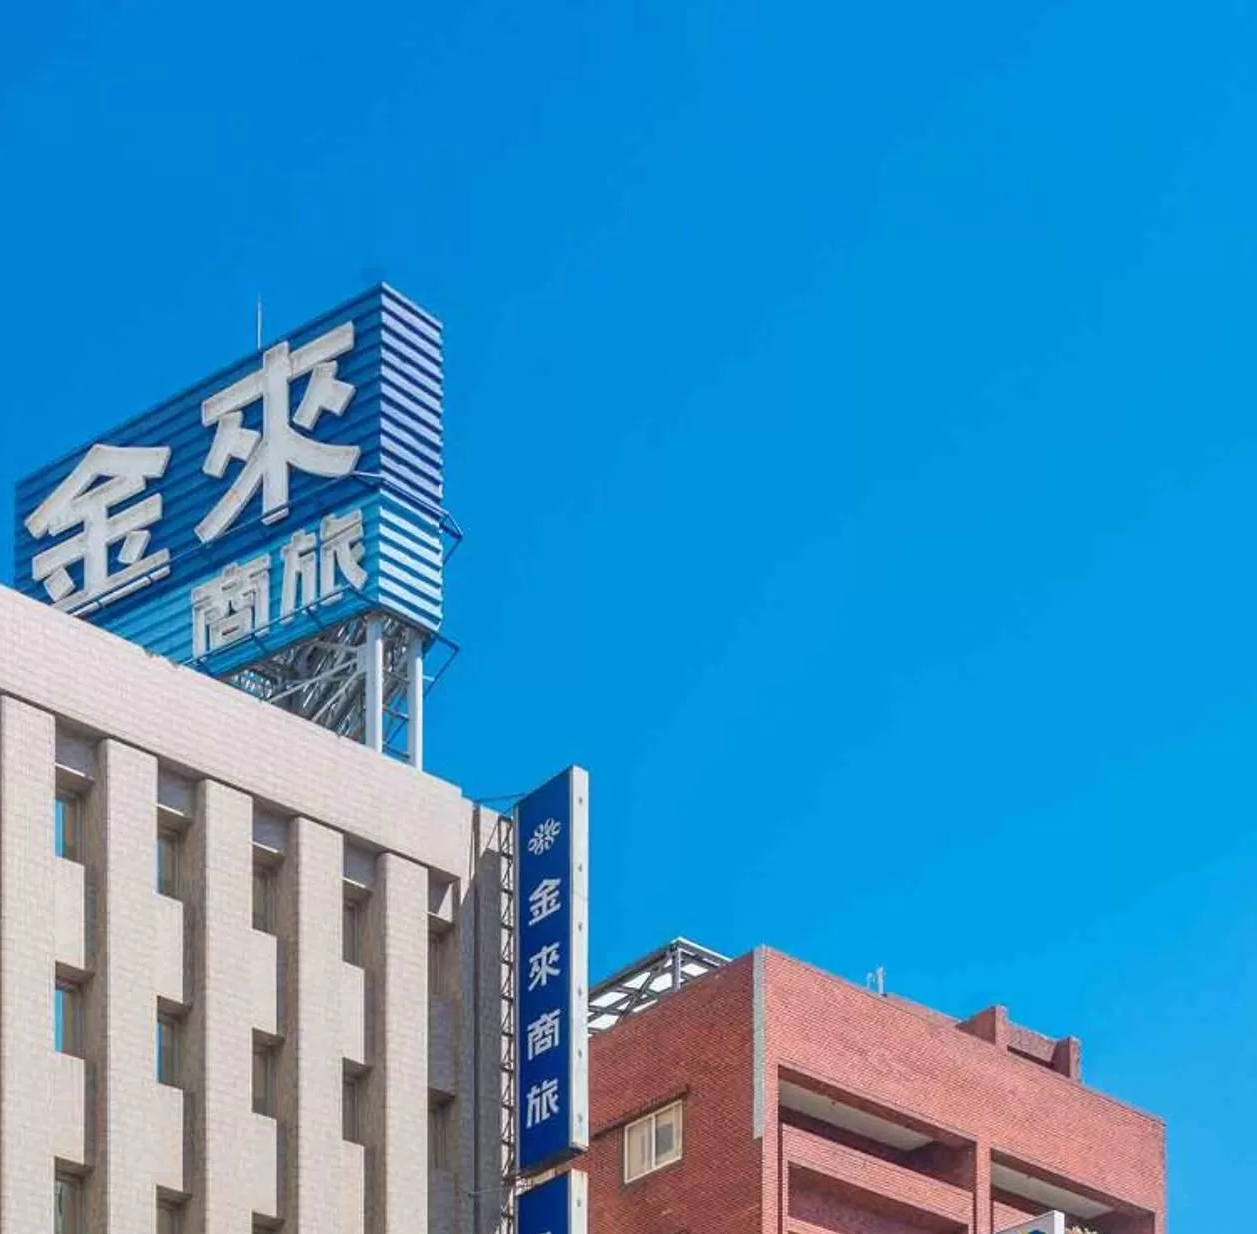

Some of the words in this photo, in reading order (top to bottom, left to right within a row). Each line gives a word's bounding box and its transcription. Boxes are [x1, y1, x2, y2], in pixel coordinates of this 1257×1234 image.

[25, 321, 360, 616] 金來
[192, 508, 368, 658] 商旅
[526, 878, 561, 1129] 金來商旅
